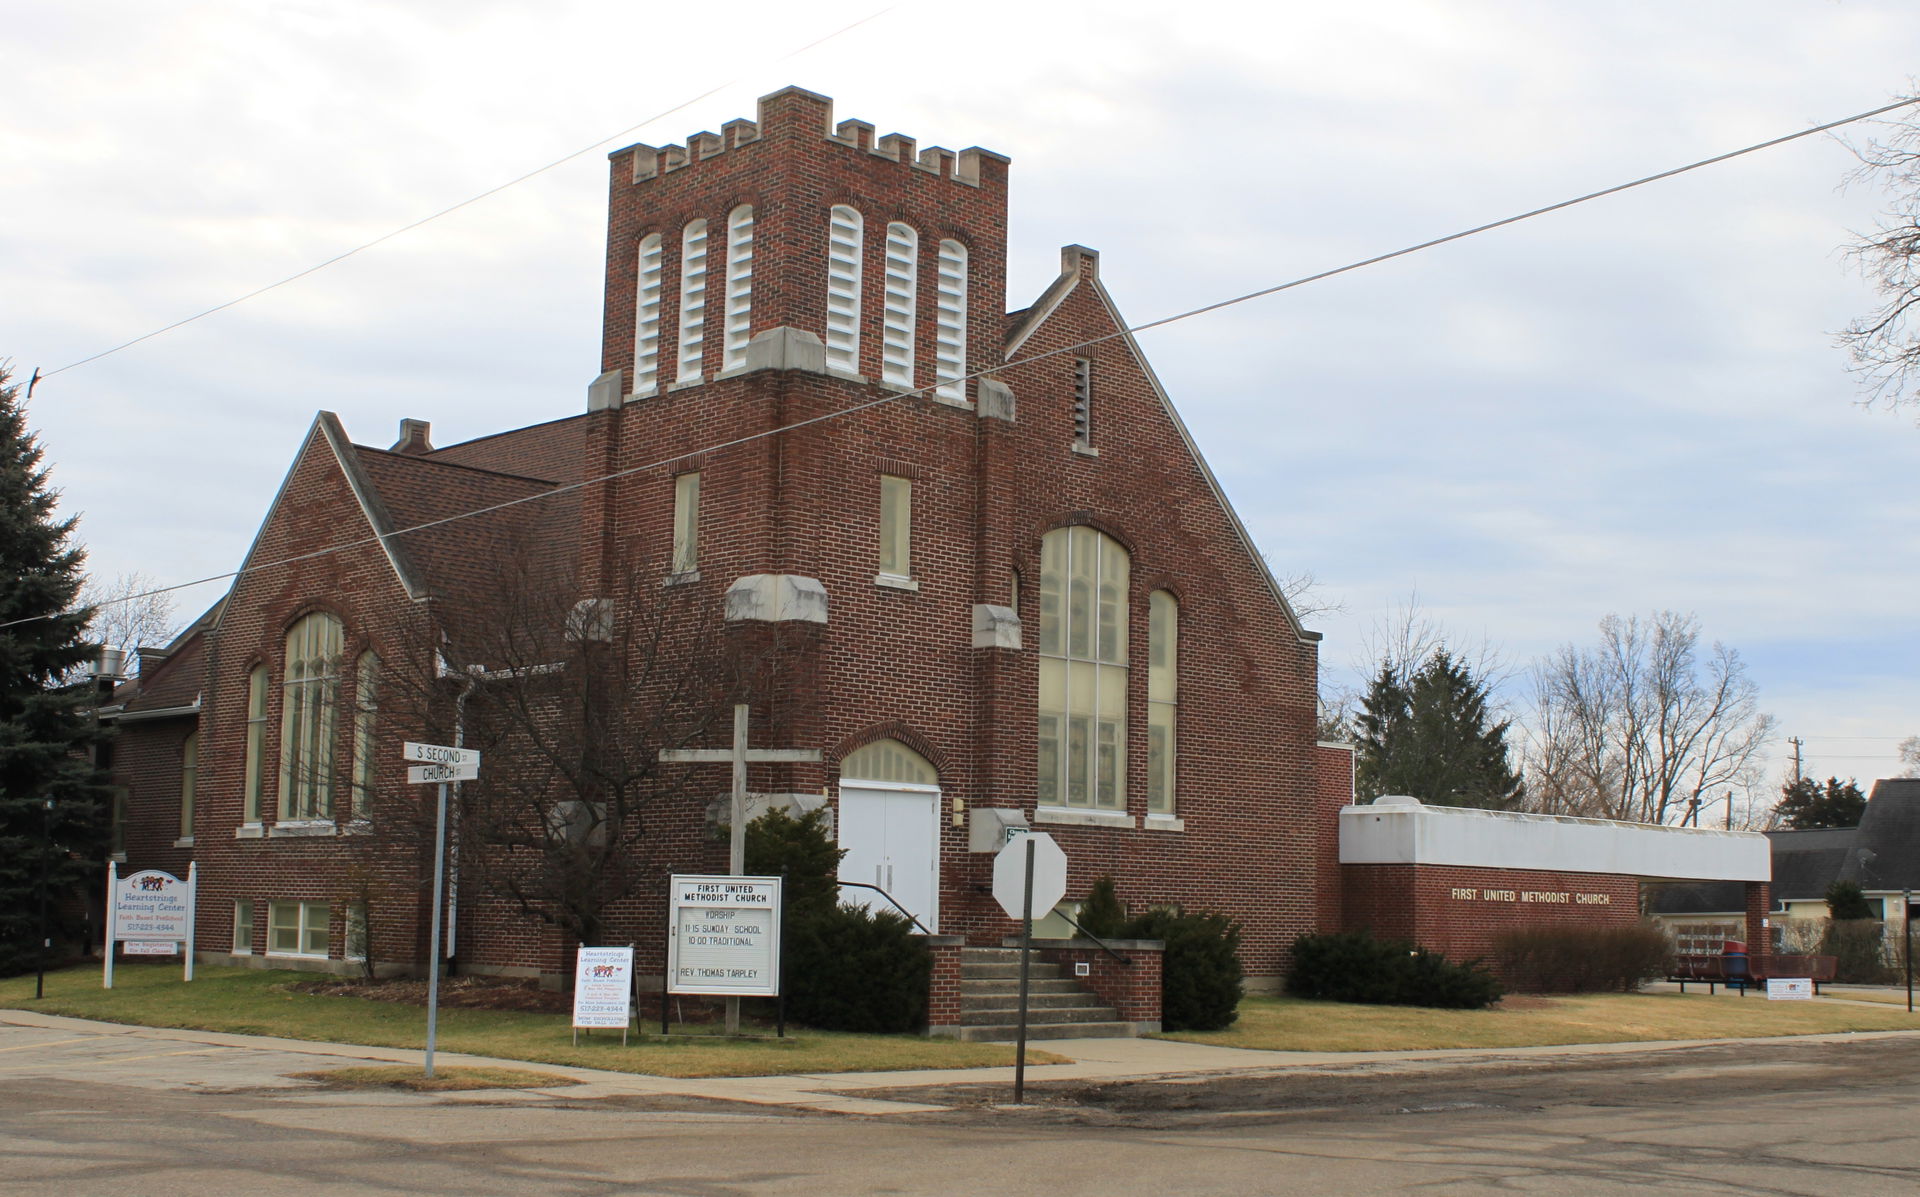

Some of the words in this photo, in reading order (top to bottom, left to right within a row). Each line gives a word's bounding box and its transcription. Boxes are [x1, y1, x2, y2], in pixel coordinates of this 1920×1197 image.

[417, 746, 423, 758] S
[427, 748, 460, 763] SECOND
[423, 766, 455, 780] CHURCH
[697, 884, 720, 892] FIRST
[725, 885, 754, 894] UNITED
[125, 892, 178, 904] Heartstrings
[684, 893, 729, 901] METHODIST
[735, 894, 767, 903] CHURCH
[1451, 888, 1477, 900] FIRST
[1483, 889, 1516, 902] UNITED
[1521, 891, 1570, 904] METHODIST
[1575, 892, 1610, 905] CHURCH
[118, 902, 155, 912] Learning
[158, 903, 185, 911] Center
[706, 910, 735, 919] WORSHIP
[127, 923, 175, 931] 517-223-4344
[702, 925, 729, 933] SUNDAY
[734, 925, 761, 934] SCHOOL
[709, 937, 753, 946] TRADITIONAL
[680, 968, 694, 976] REV
[698, 968, 725, 977] THOMAS
[727, 968, 758, 978] TARPLEY
